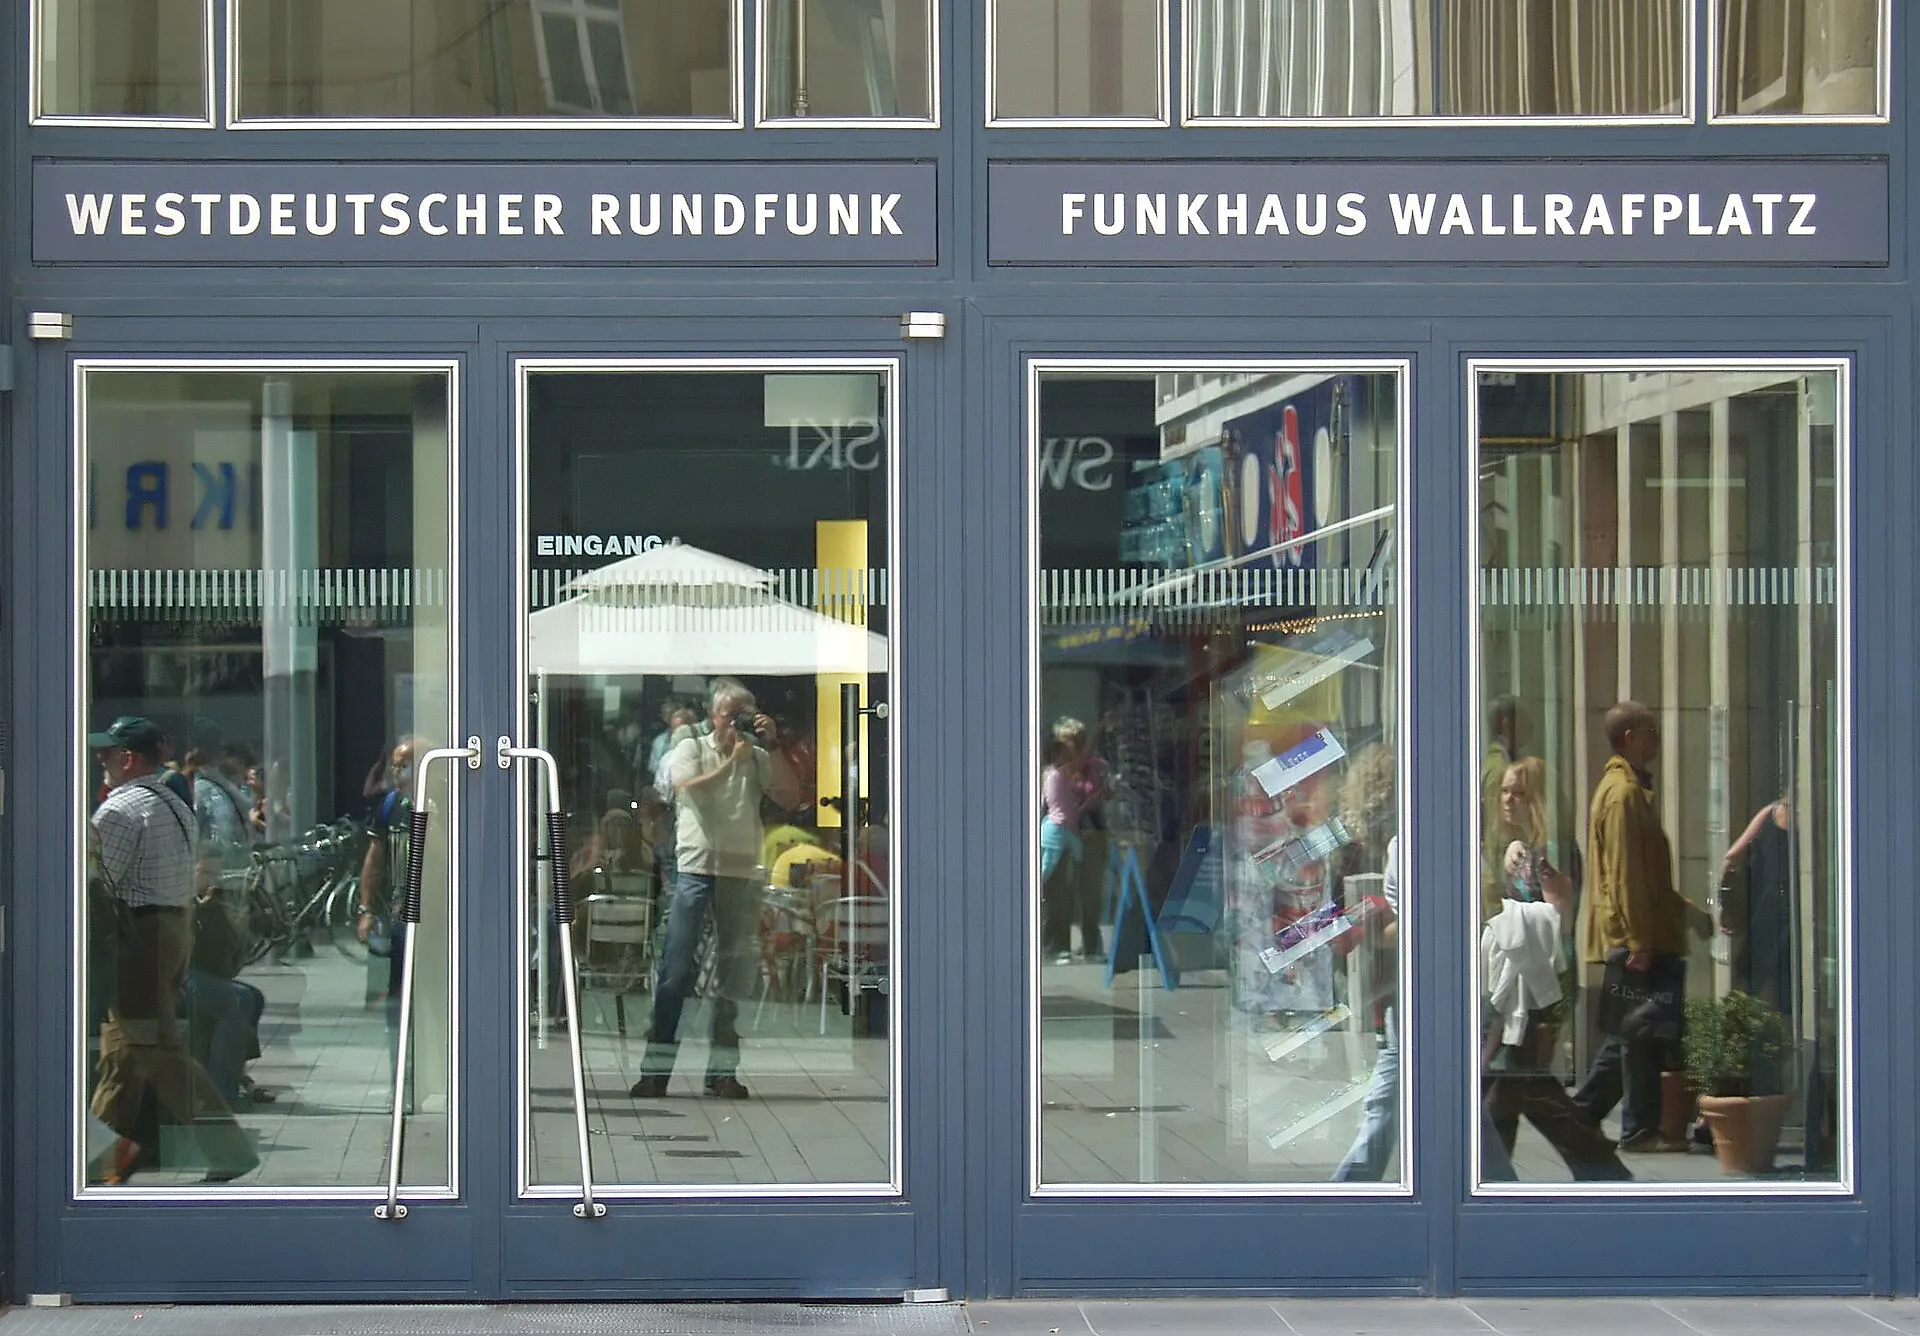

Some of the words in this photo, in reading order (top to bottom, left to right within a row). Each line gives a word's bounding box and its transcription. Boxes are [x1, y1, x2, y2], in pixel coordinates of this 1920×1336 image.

[64, 192, 564, 237] WESTDEUTSCHER
[591, 193, 904, 237] RUNDFUNK
[1061, 192, 1367, 237] FUNKHAUS
[1388, 193, 1818, 236] WALLRAFPLATZ
[537, 534, 663, 556] EINGANG
